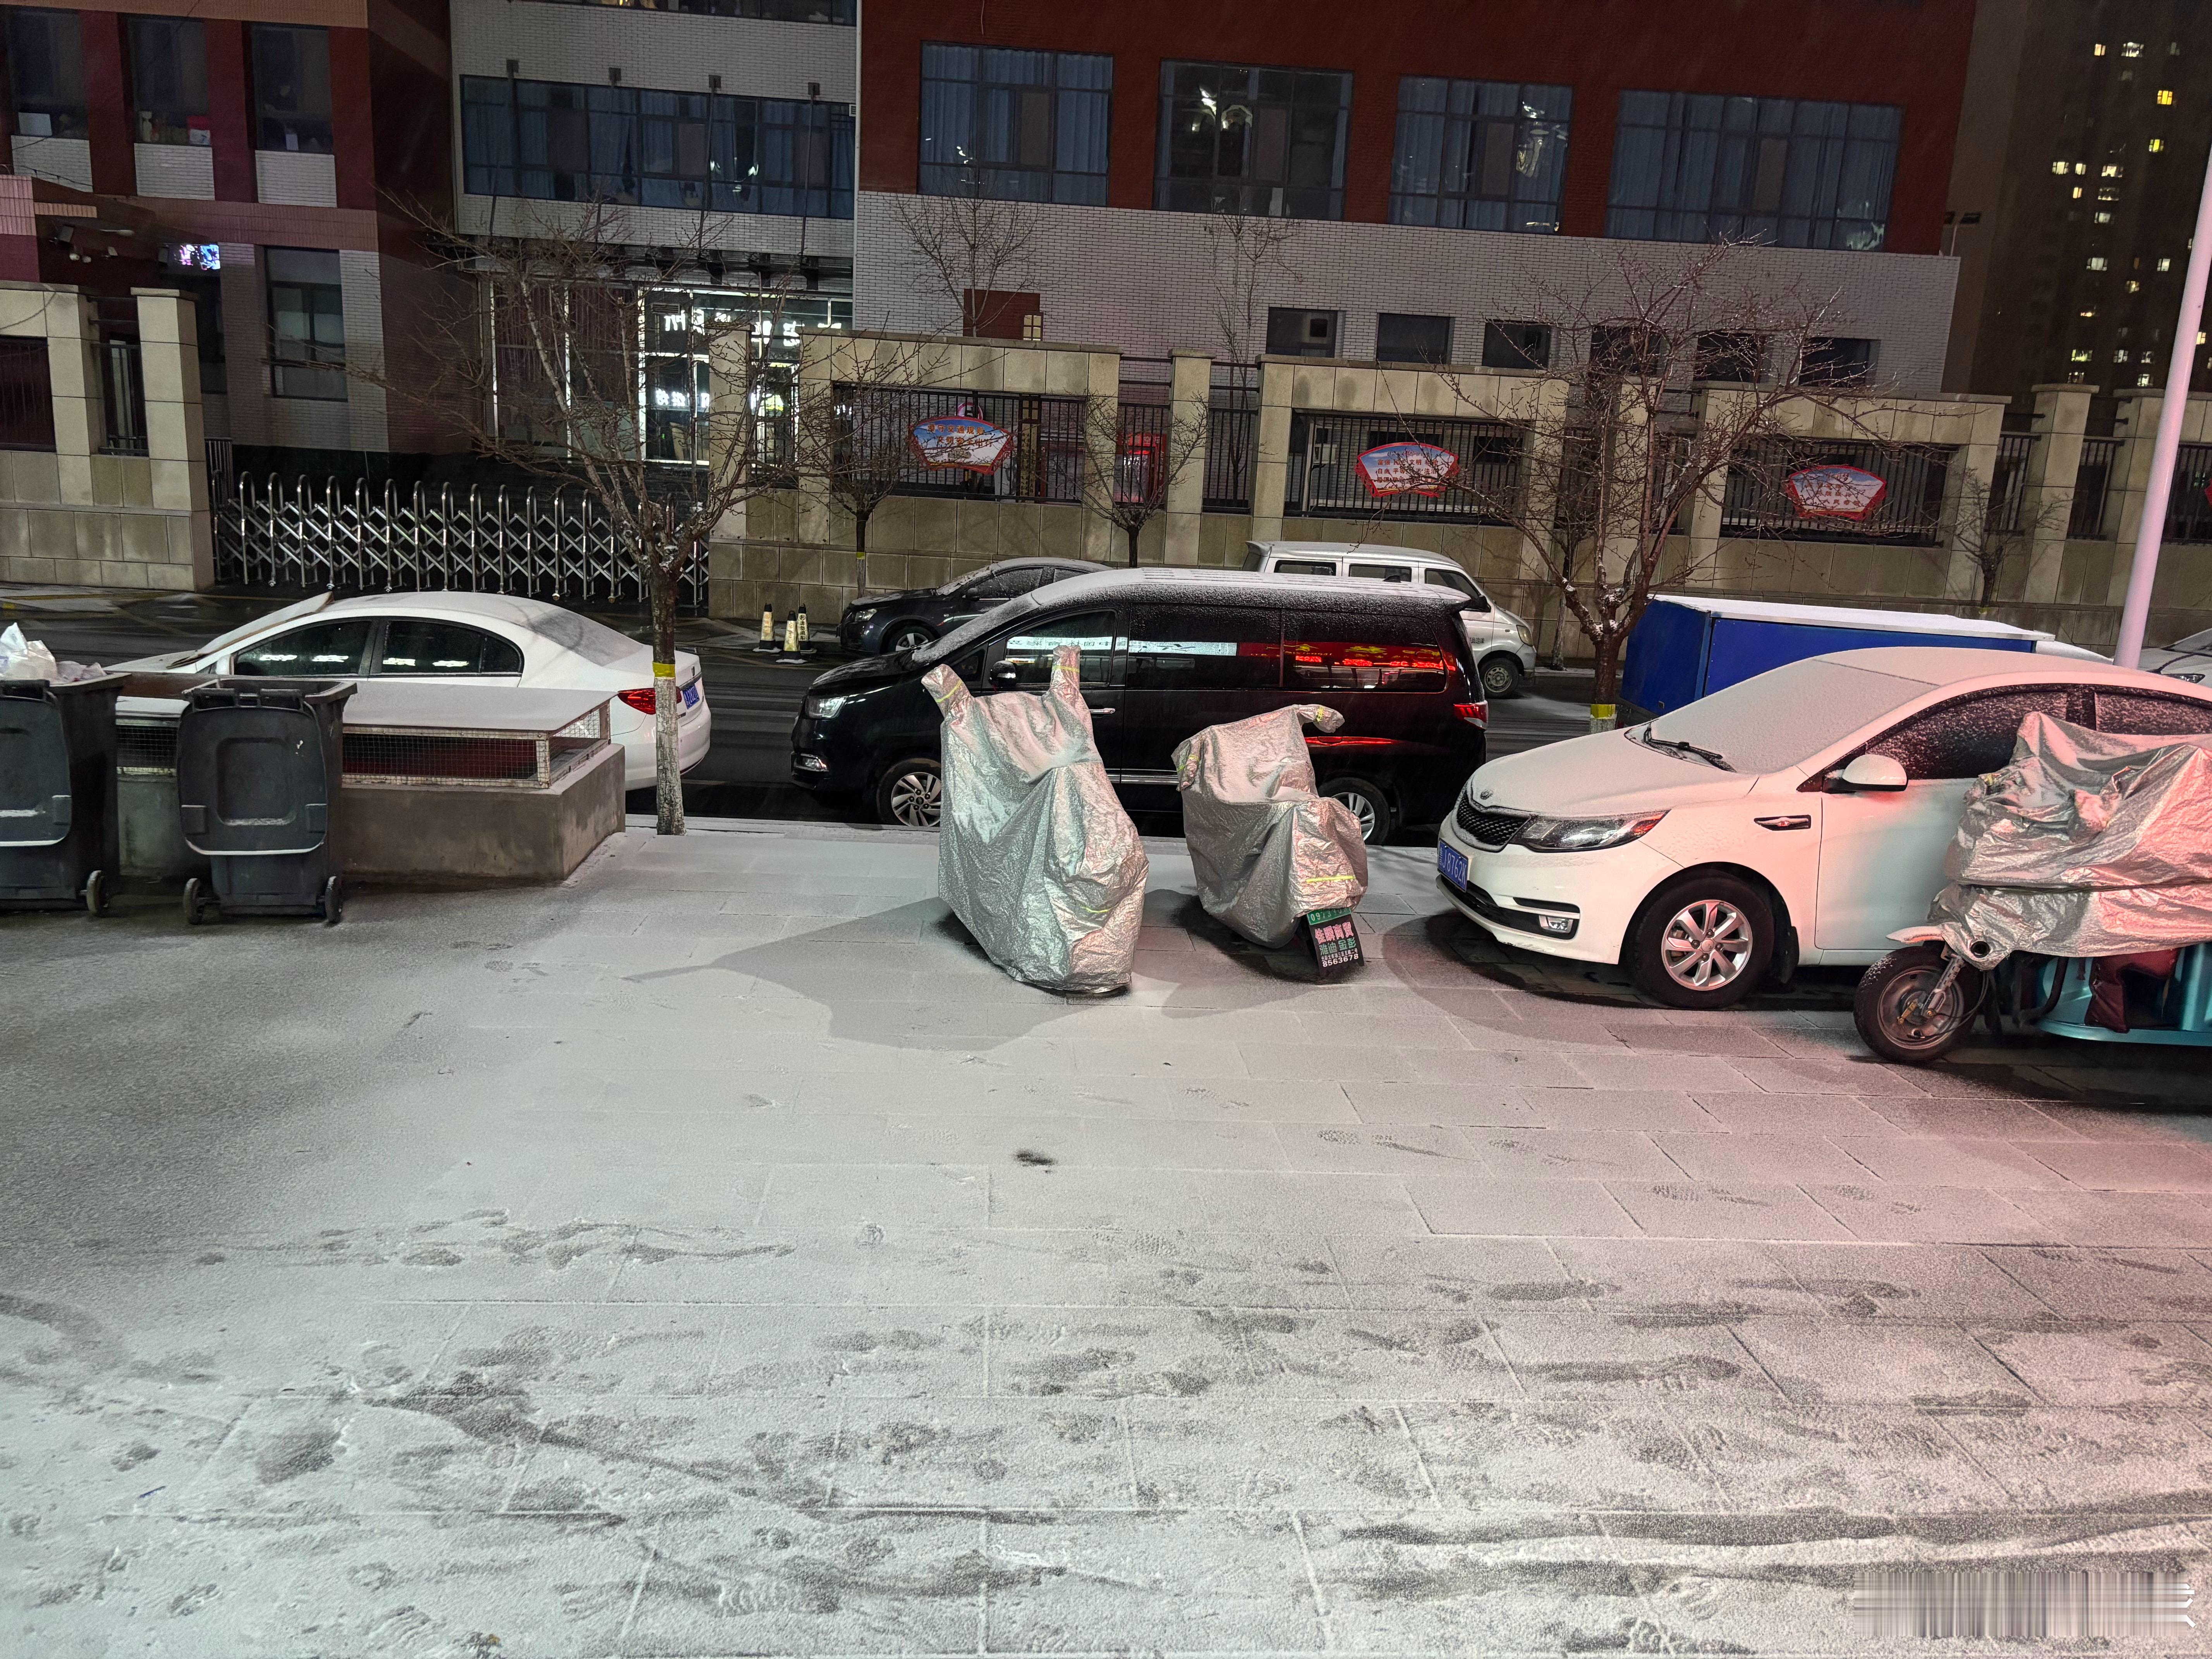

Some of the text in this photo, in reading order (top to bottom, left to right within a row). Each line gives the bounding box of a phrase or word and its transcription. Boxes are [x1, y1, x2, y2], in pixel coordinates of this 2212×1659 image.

[928, 424, 985, 434] 遵守交通规则
[1439, 847, 1467, 885] 鲁J8762K
[1319, 937, 1357, 955] 雅迪 金彭
[1322, 953, 1359, 967] 8563678
